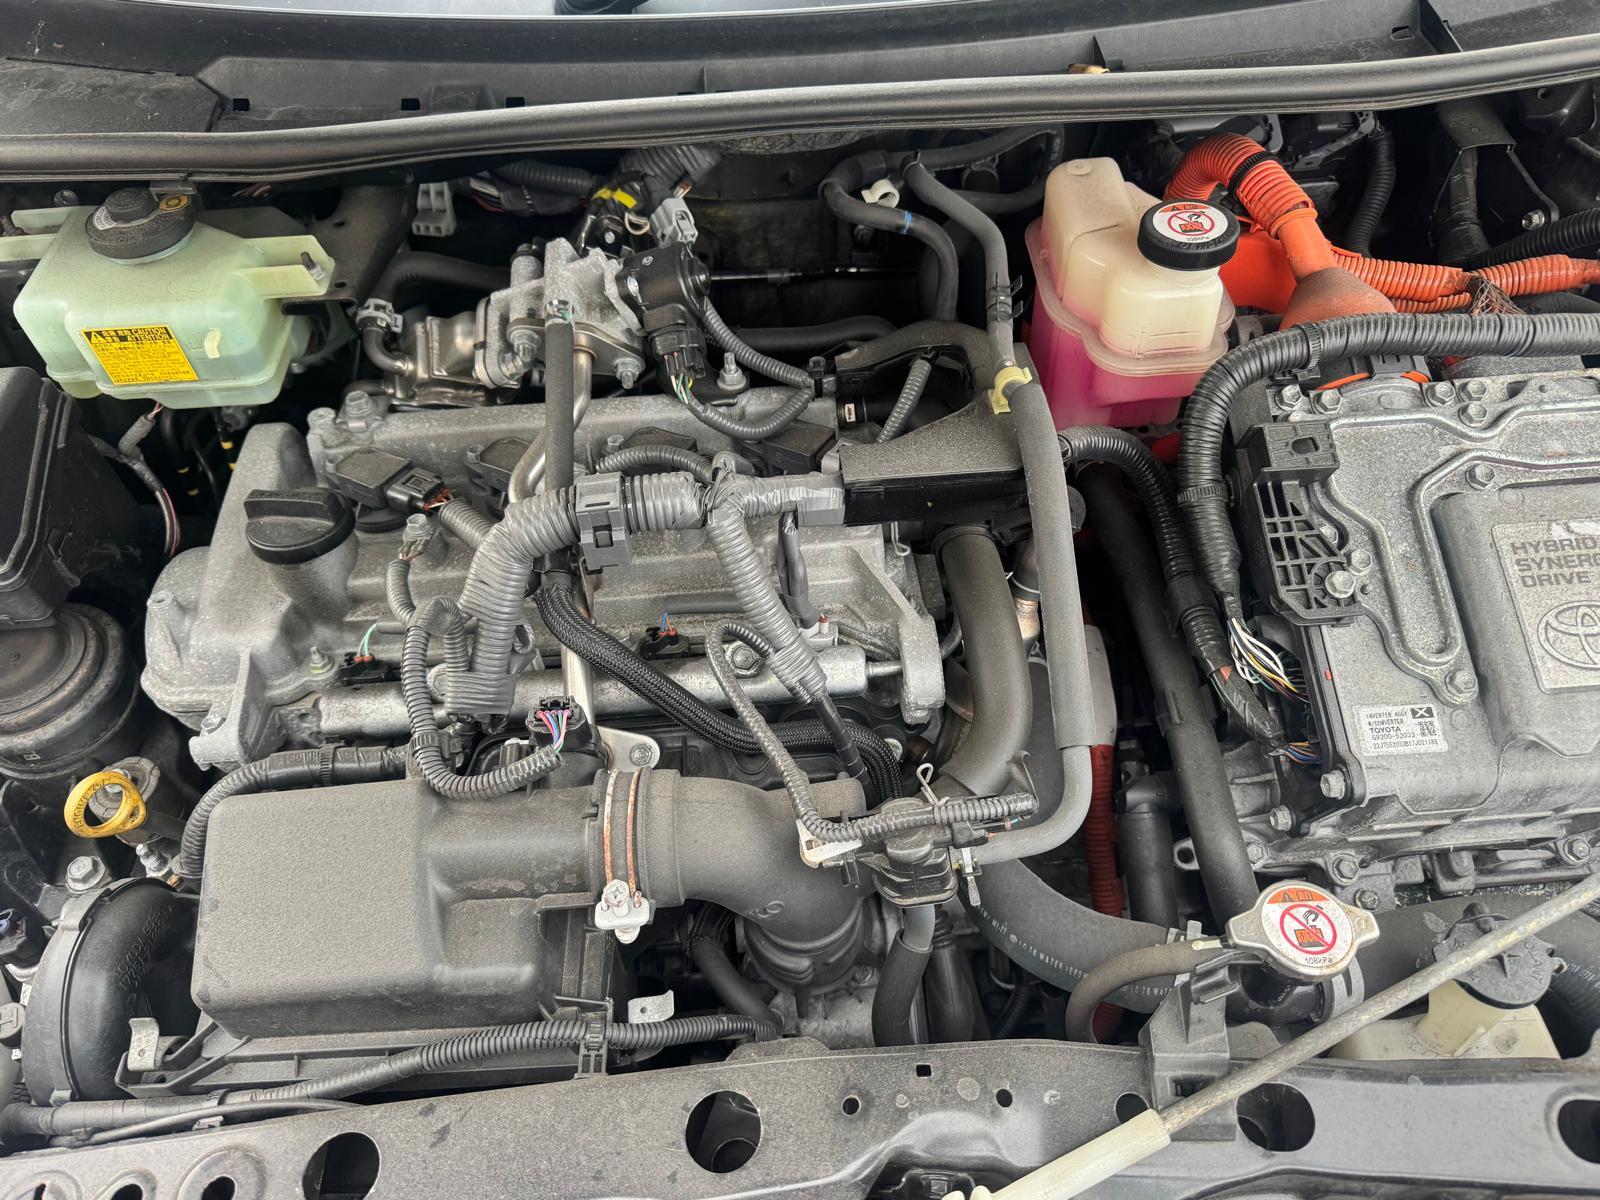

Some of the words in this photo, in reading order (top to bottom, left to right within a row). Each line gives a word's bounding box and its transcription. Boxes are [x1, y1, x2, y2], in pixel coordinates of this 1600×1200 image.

[127, 332, 171, 342] ATTENTION
[131, 327, 166, 336] CAUTION
[1510, 537, 1597, 555] HYBRID
[1520, 571, 1591, 588] DRIVE
[1369, 726, 1402, 734] TOYOTA
[1040, 952, 1063, 969] WATER
[1304, 955, 1333, 966] 108kPa
